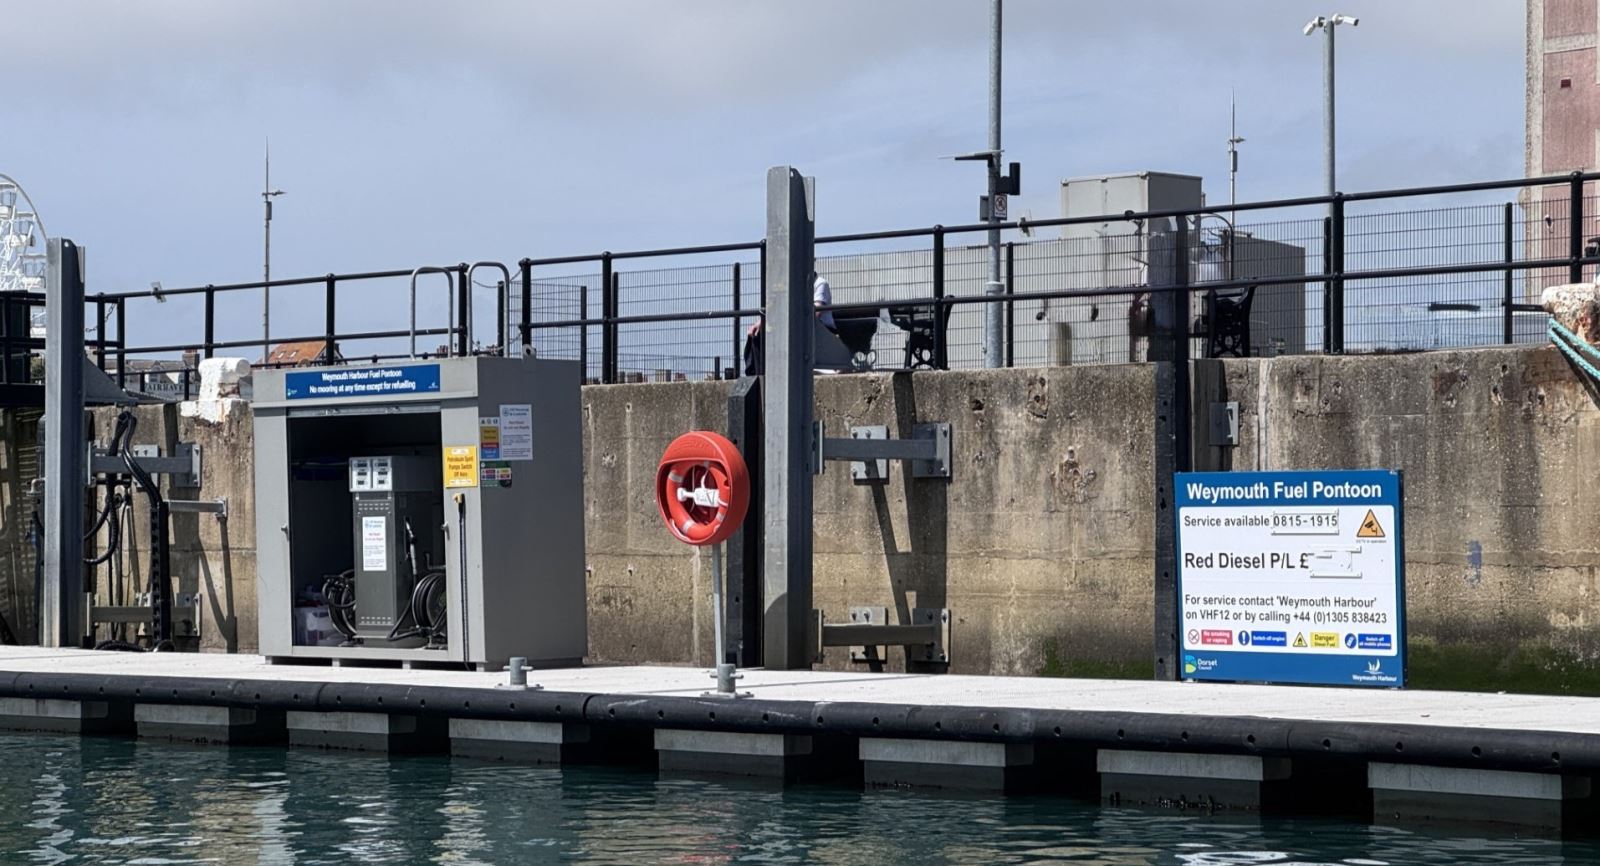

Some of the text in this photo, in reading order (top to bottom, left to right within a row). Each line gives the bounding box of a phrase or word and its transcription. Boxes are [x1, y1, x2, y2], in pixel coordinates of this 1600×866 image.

[322, 369, 402, 383] Weymouth Harbour Fuel Pontoon
[318, 385, 338, 395] mooring
[345, 385, 354, 394] any
[354, 383, 365, 391] time
[367, 383, 383, 392] except
[383, 381, 391, 389] for
[392, 380, 416, 390] refuelling
[1186, 481, 1382, 504] Weymouth Fuel Pontoon
[1184, 515, 1338, 527] Service available 0815-1915
[1184, 552, 1309, 569] Red Diesel P/L £
[1185, 594, 1377, 610] For service contact 'Weymouth Harbour'
[1185, 610, 1387, 624] on VHF12 or by calling +44 (0)1305 838423
[1314, 634, 1335, 642] Danger
[1198, 658, 1217, 666] Dorset
[1352, 674, 1377, 682] Weymouth
